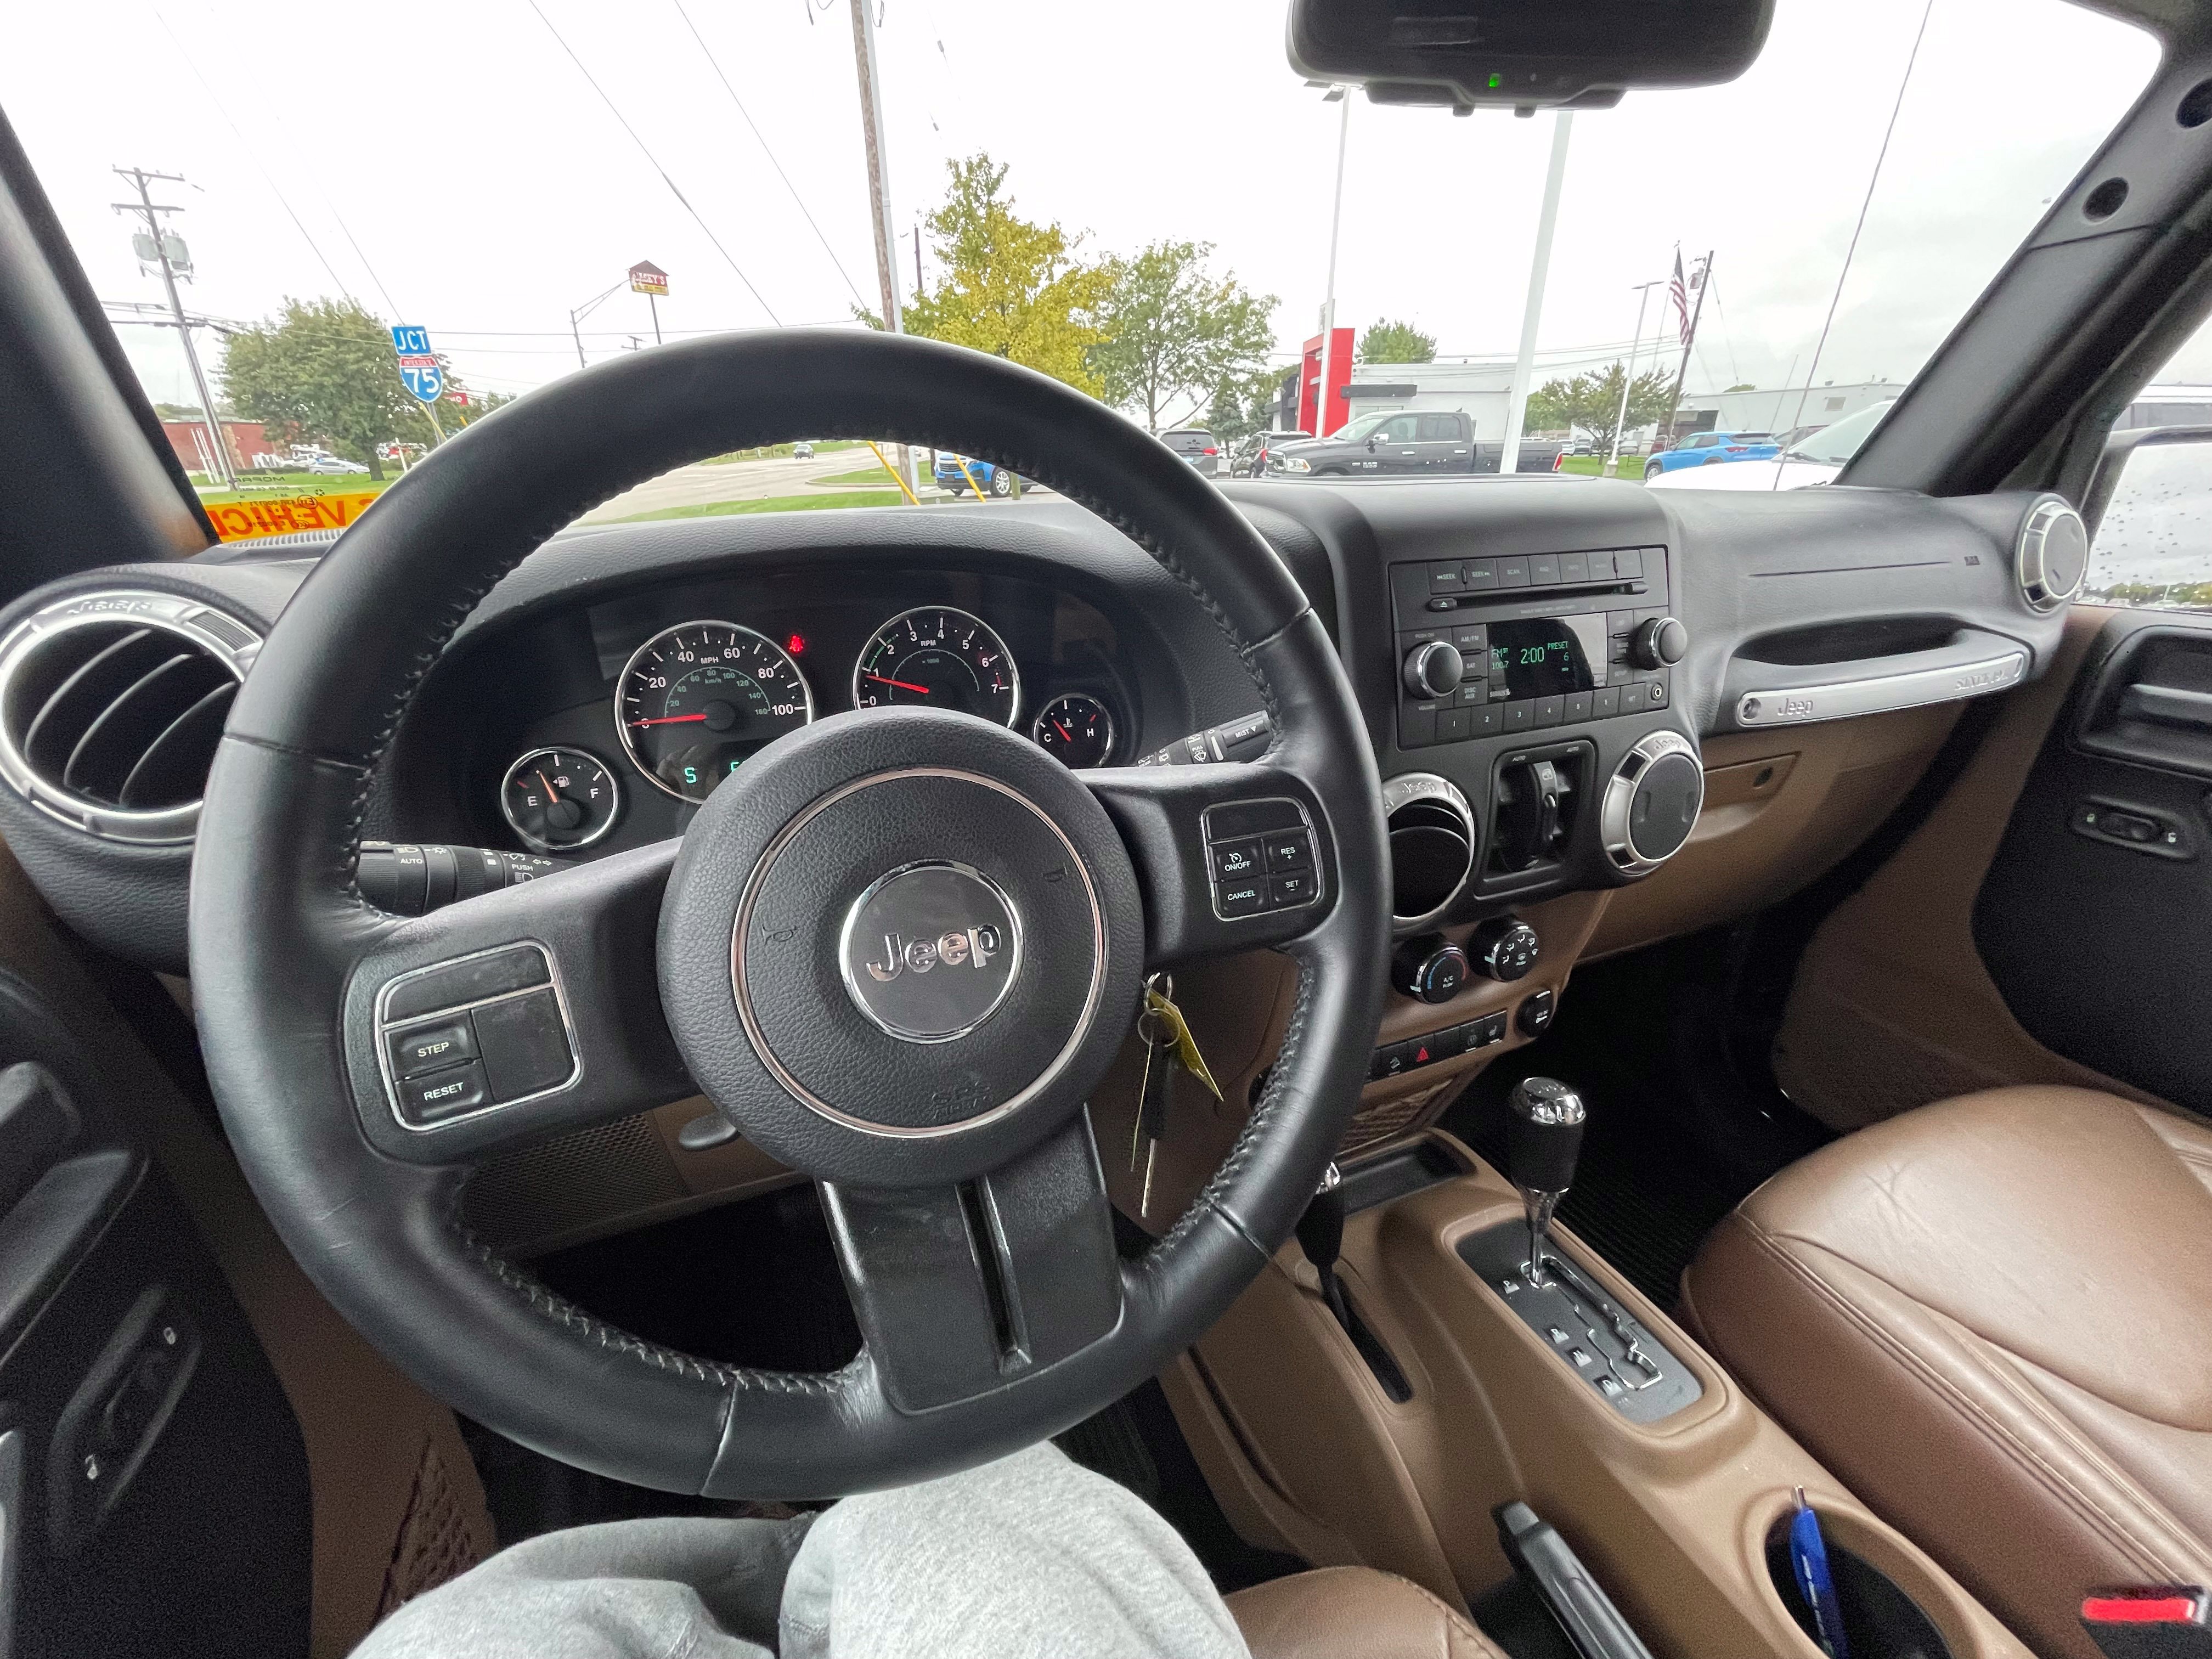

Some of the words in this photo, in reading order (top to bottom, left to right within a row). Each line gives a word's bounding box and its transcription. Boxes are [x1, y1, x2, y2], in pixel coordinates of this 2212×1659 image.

[398, 330, 426, 351] JCT
[404, 368, 439, 393] 75
[910, 631, 918, 642] 3
[938, 629, 945, 640] 4
[887, 644, 895, 656] 2
[962, 640, 969, 650] 5
[1547, 641, 1568, 650] PRESET
[677, 651, 695, 663] 40
[723, 647, 741, 659] 60
[1521, 647, 1544, 664] 2:00
[1564, 653, 1569, 662] 6
[701, 656, 719, 664] MPH
[981, 657, 989, 668] 6
[706, 669, 716, 677] 80
[723, 672, 735, 680] 100
[758, 667, 775, 679] 80
[648, 676, 667, 689] 20
[991, 684, 998, 693] 7
[748, 691, 761, 700] 140
[868, 695, 877, 706] 0
[669, 699, 680, 708] 20
[1777, 697, 1814, 718] Jeep
[755, 707, 768, 715] 160
[771, 704, 794, 716] 100
[1044, 733, 1052, 742] C
[1087, 728, 1094, 737] H
[1234, 727, 1250, 738] MIST
[684, 767, 697, 783] S
[590, 787, 599, 799] F
[527, 795, 538, 806] E
[1280, 847, 1295, 855] RES
[511, 863, 533, 871] PUSH
[1224, 860, 1251, 872] ON/OFF
[1285, 879, 1299, 888] SET
[1227, 889, 1256, 901] CANCEL
[865, 923, 1003, 983] Jeep
[1443, 975, 1453, 983] A/C
[417, 1041, 450, 1057] STEP
[424, 1081, 465, 1102] RESET
